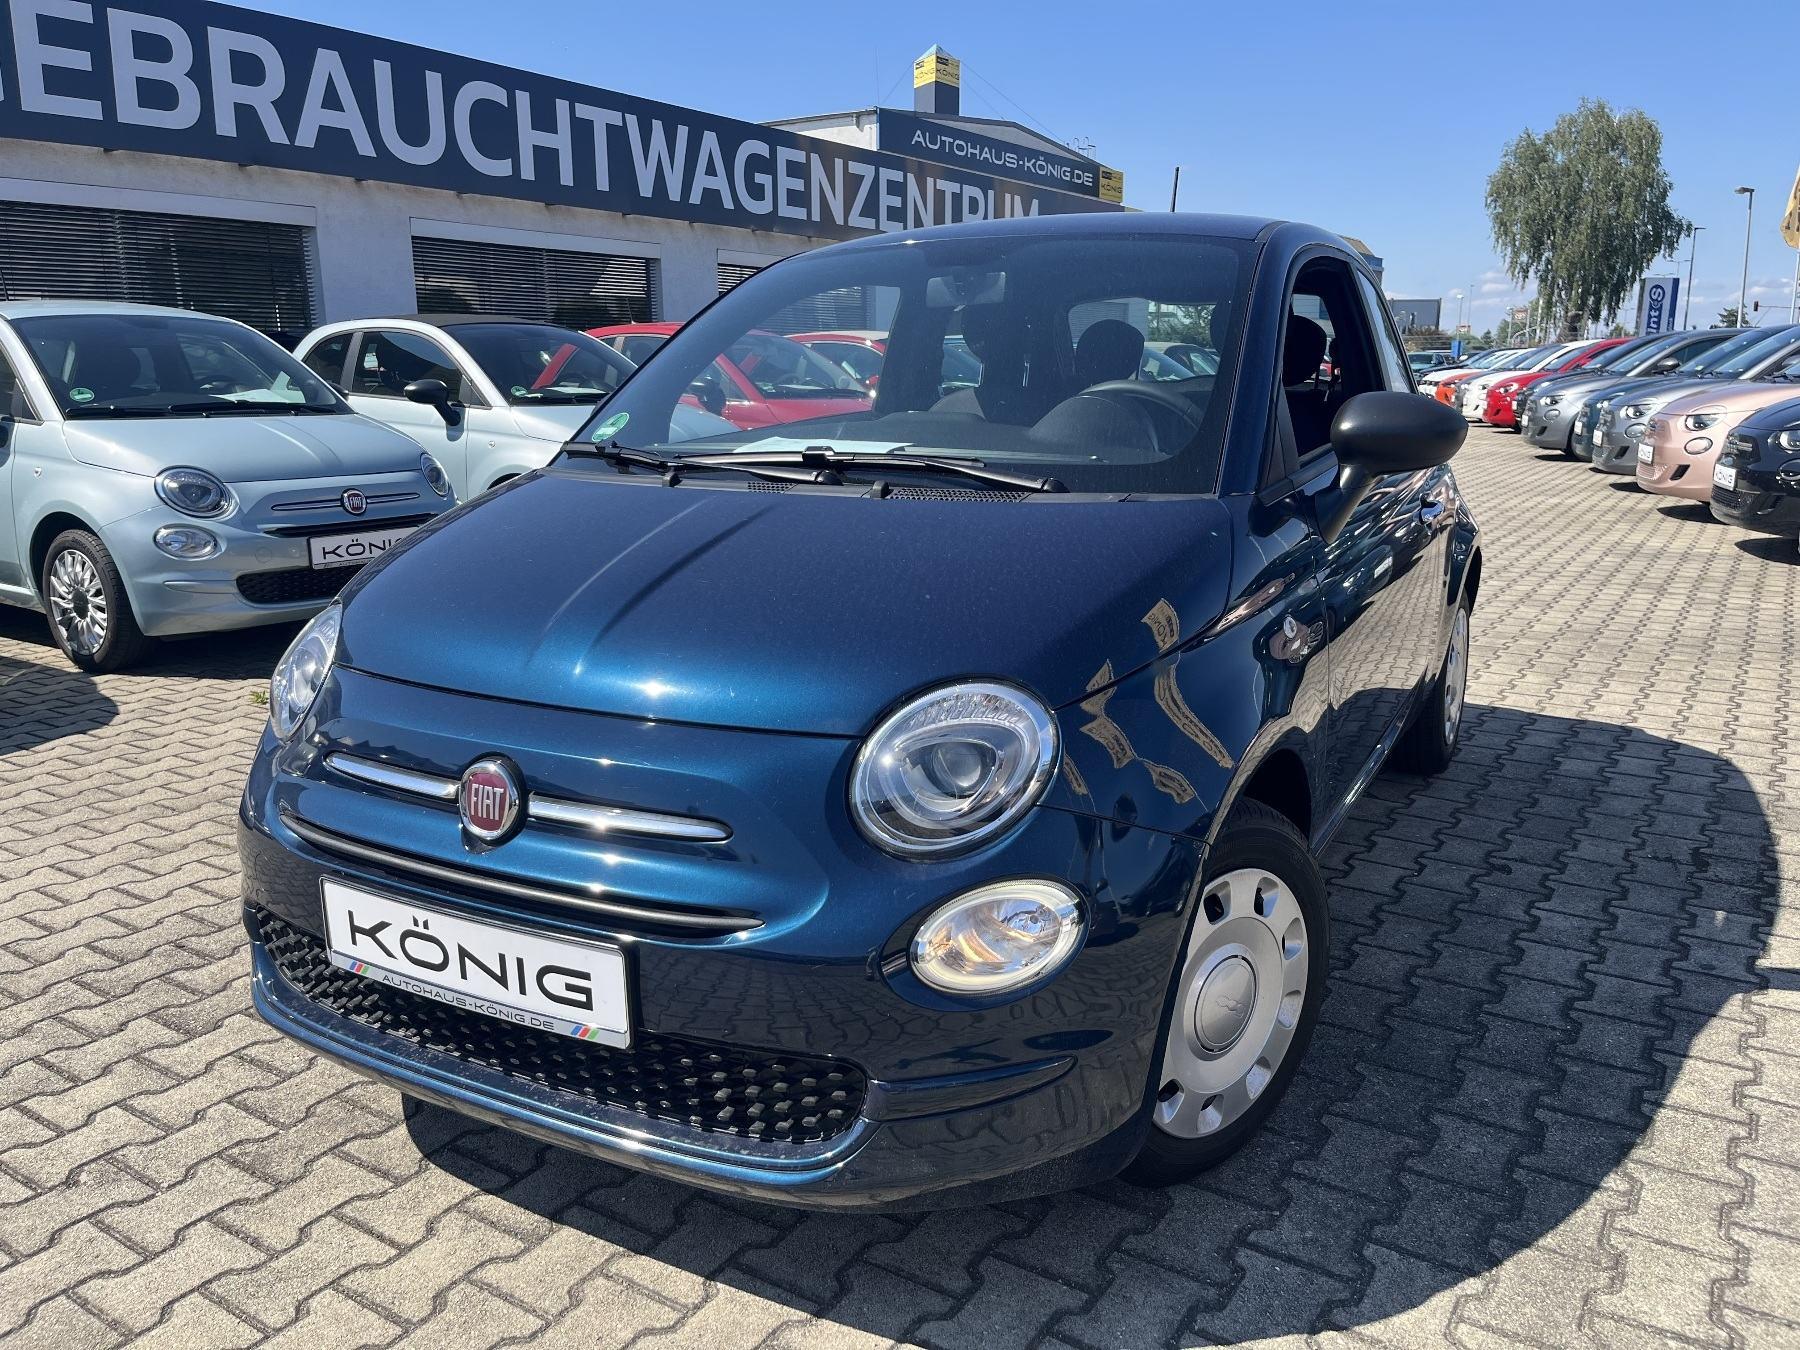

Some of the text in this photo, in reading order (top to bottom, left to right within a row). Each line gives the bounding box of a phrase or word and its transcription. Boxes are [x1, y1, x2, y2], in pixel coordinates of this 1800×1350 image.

[0, 0, 1039, 233] EBRAUCHTWAGENZENTR
[911, 129, 1093, 187] AUTOHAUS-KÖNIG.DE
[349, 496, 362, 508] FIAT
[322, 538, 403, 560] KÖNI
[470, 783, 505, 821] FIAT
[347, 909, 594, 1012] KÖNIG
[382, 974, 555, 1031] AUTOHAUS-KÖNIG.DE
